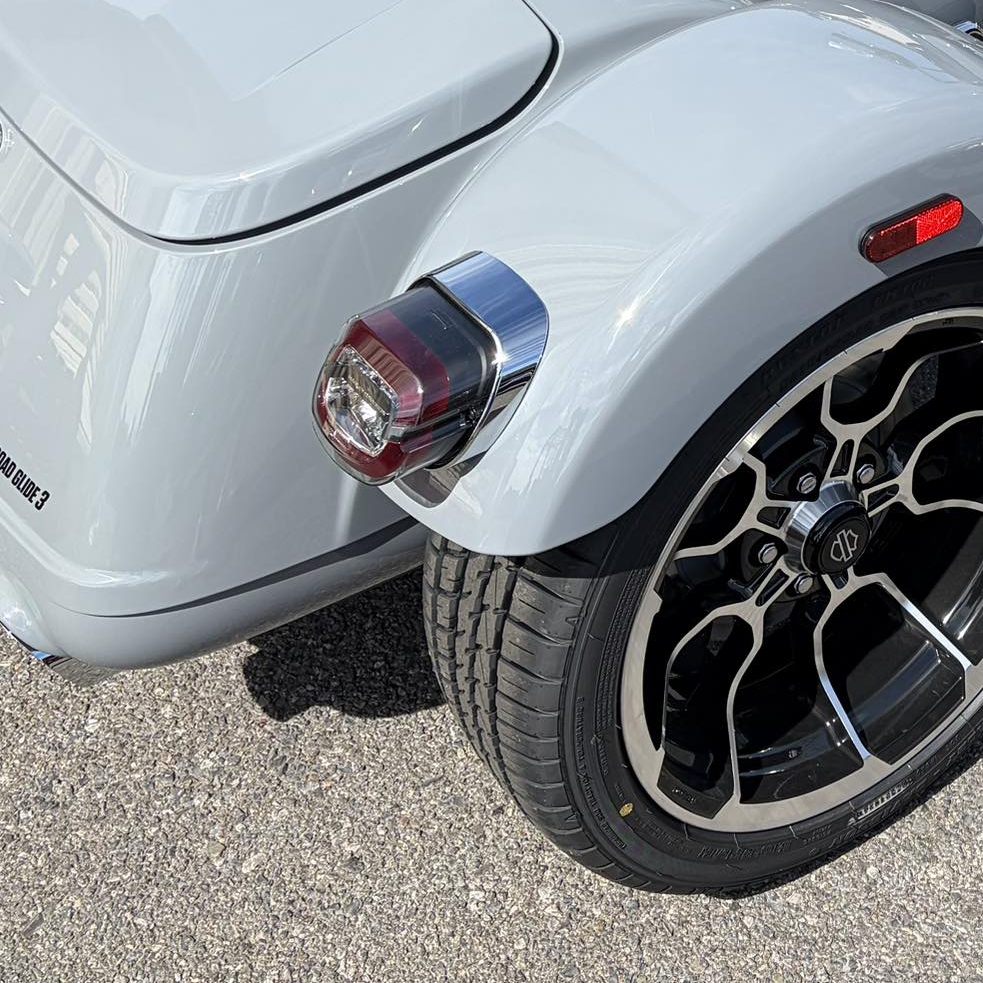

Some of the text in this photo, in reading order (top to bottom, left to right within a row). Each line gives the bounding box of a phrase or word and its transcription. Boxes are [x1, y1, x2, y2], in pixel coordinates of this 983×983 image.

[0, 447, 51, 511] OAD GLIDE 3
